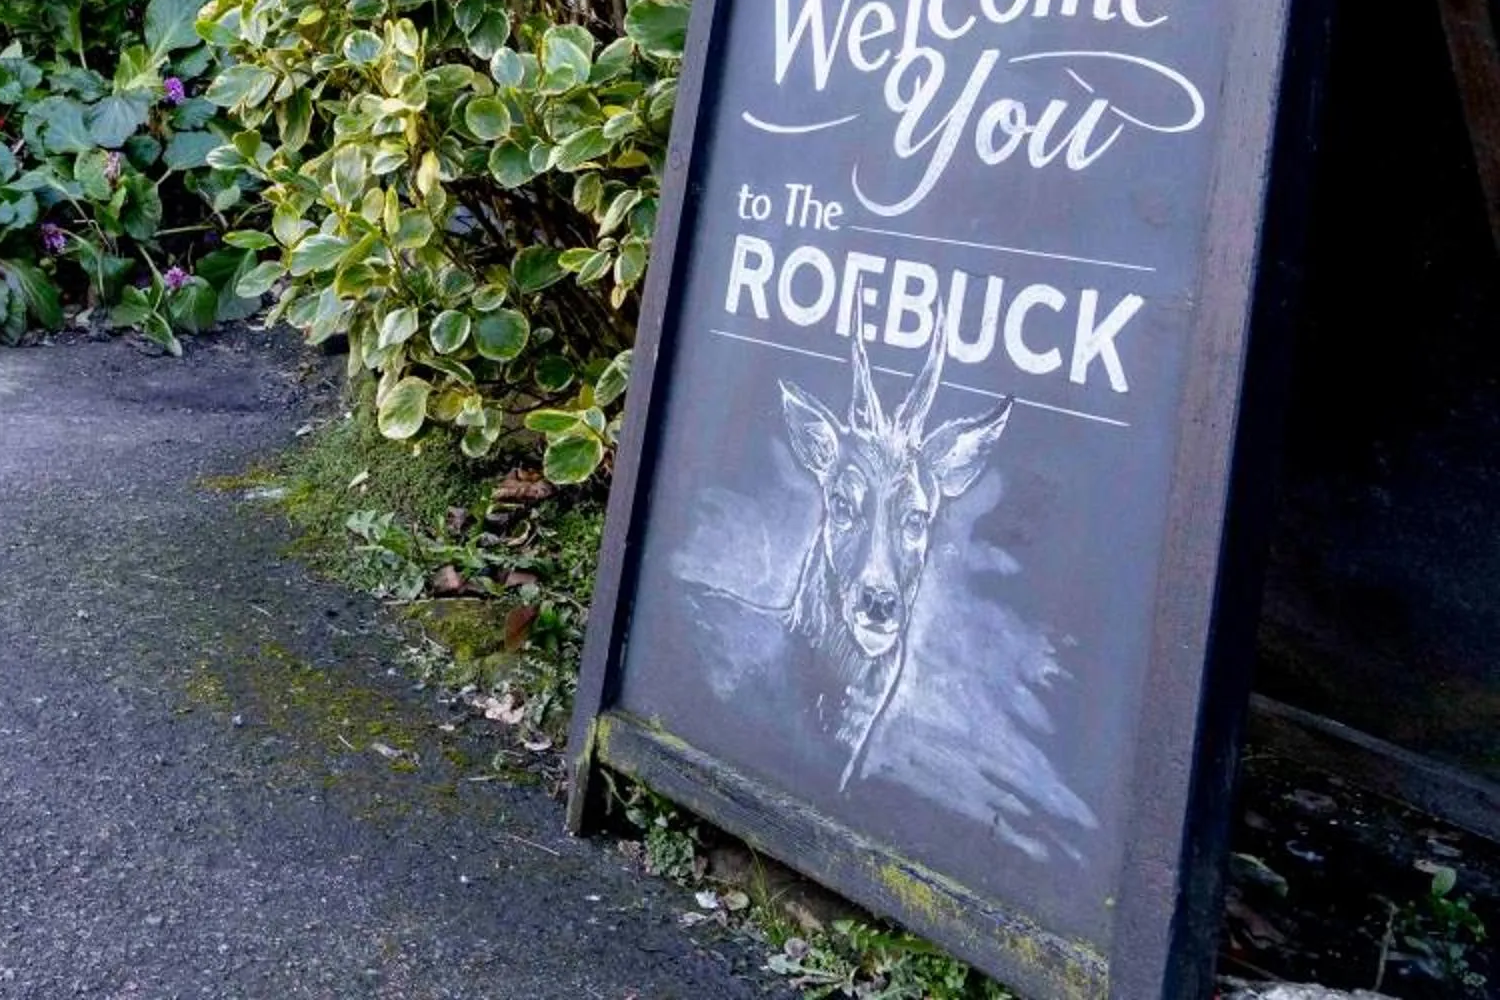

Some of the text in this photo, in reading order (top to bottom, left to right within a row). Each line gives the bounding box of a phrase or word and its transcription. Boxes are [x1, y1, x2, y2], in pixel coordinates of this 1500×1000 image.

[737, 183, 844, 231] to The
[851, 47, 1125, 217] You
[724, 234, 1145, 394] ROEBUCK
